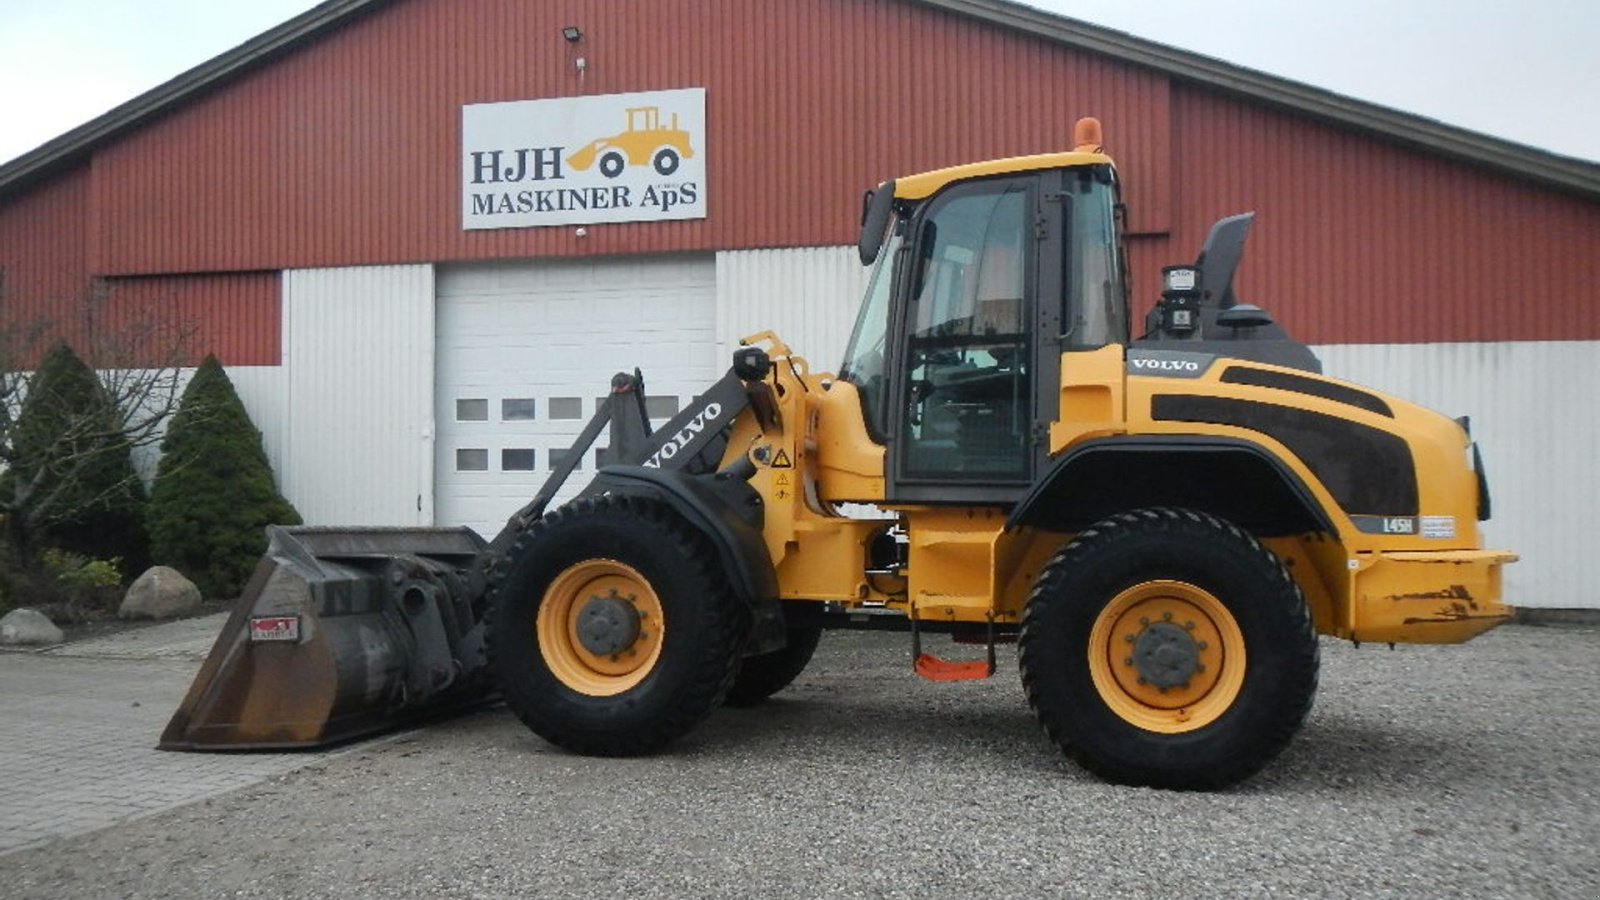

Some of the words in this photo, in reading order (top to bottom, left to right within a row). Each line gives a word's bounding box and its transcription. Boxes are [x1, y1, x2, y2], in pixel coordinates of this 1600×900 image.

[470, 147, 565, 184] HJH
[471, 185, 632, 215] MASKINER
[640, 182, 697, 212] ApS
[1133, 359, 1198, 371] VOLVO
[642, 402, 722, 469] VOLVO
